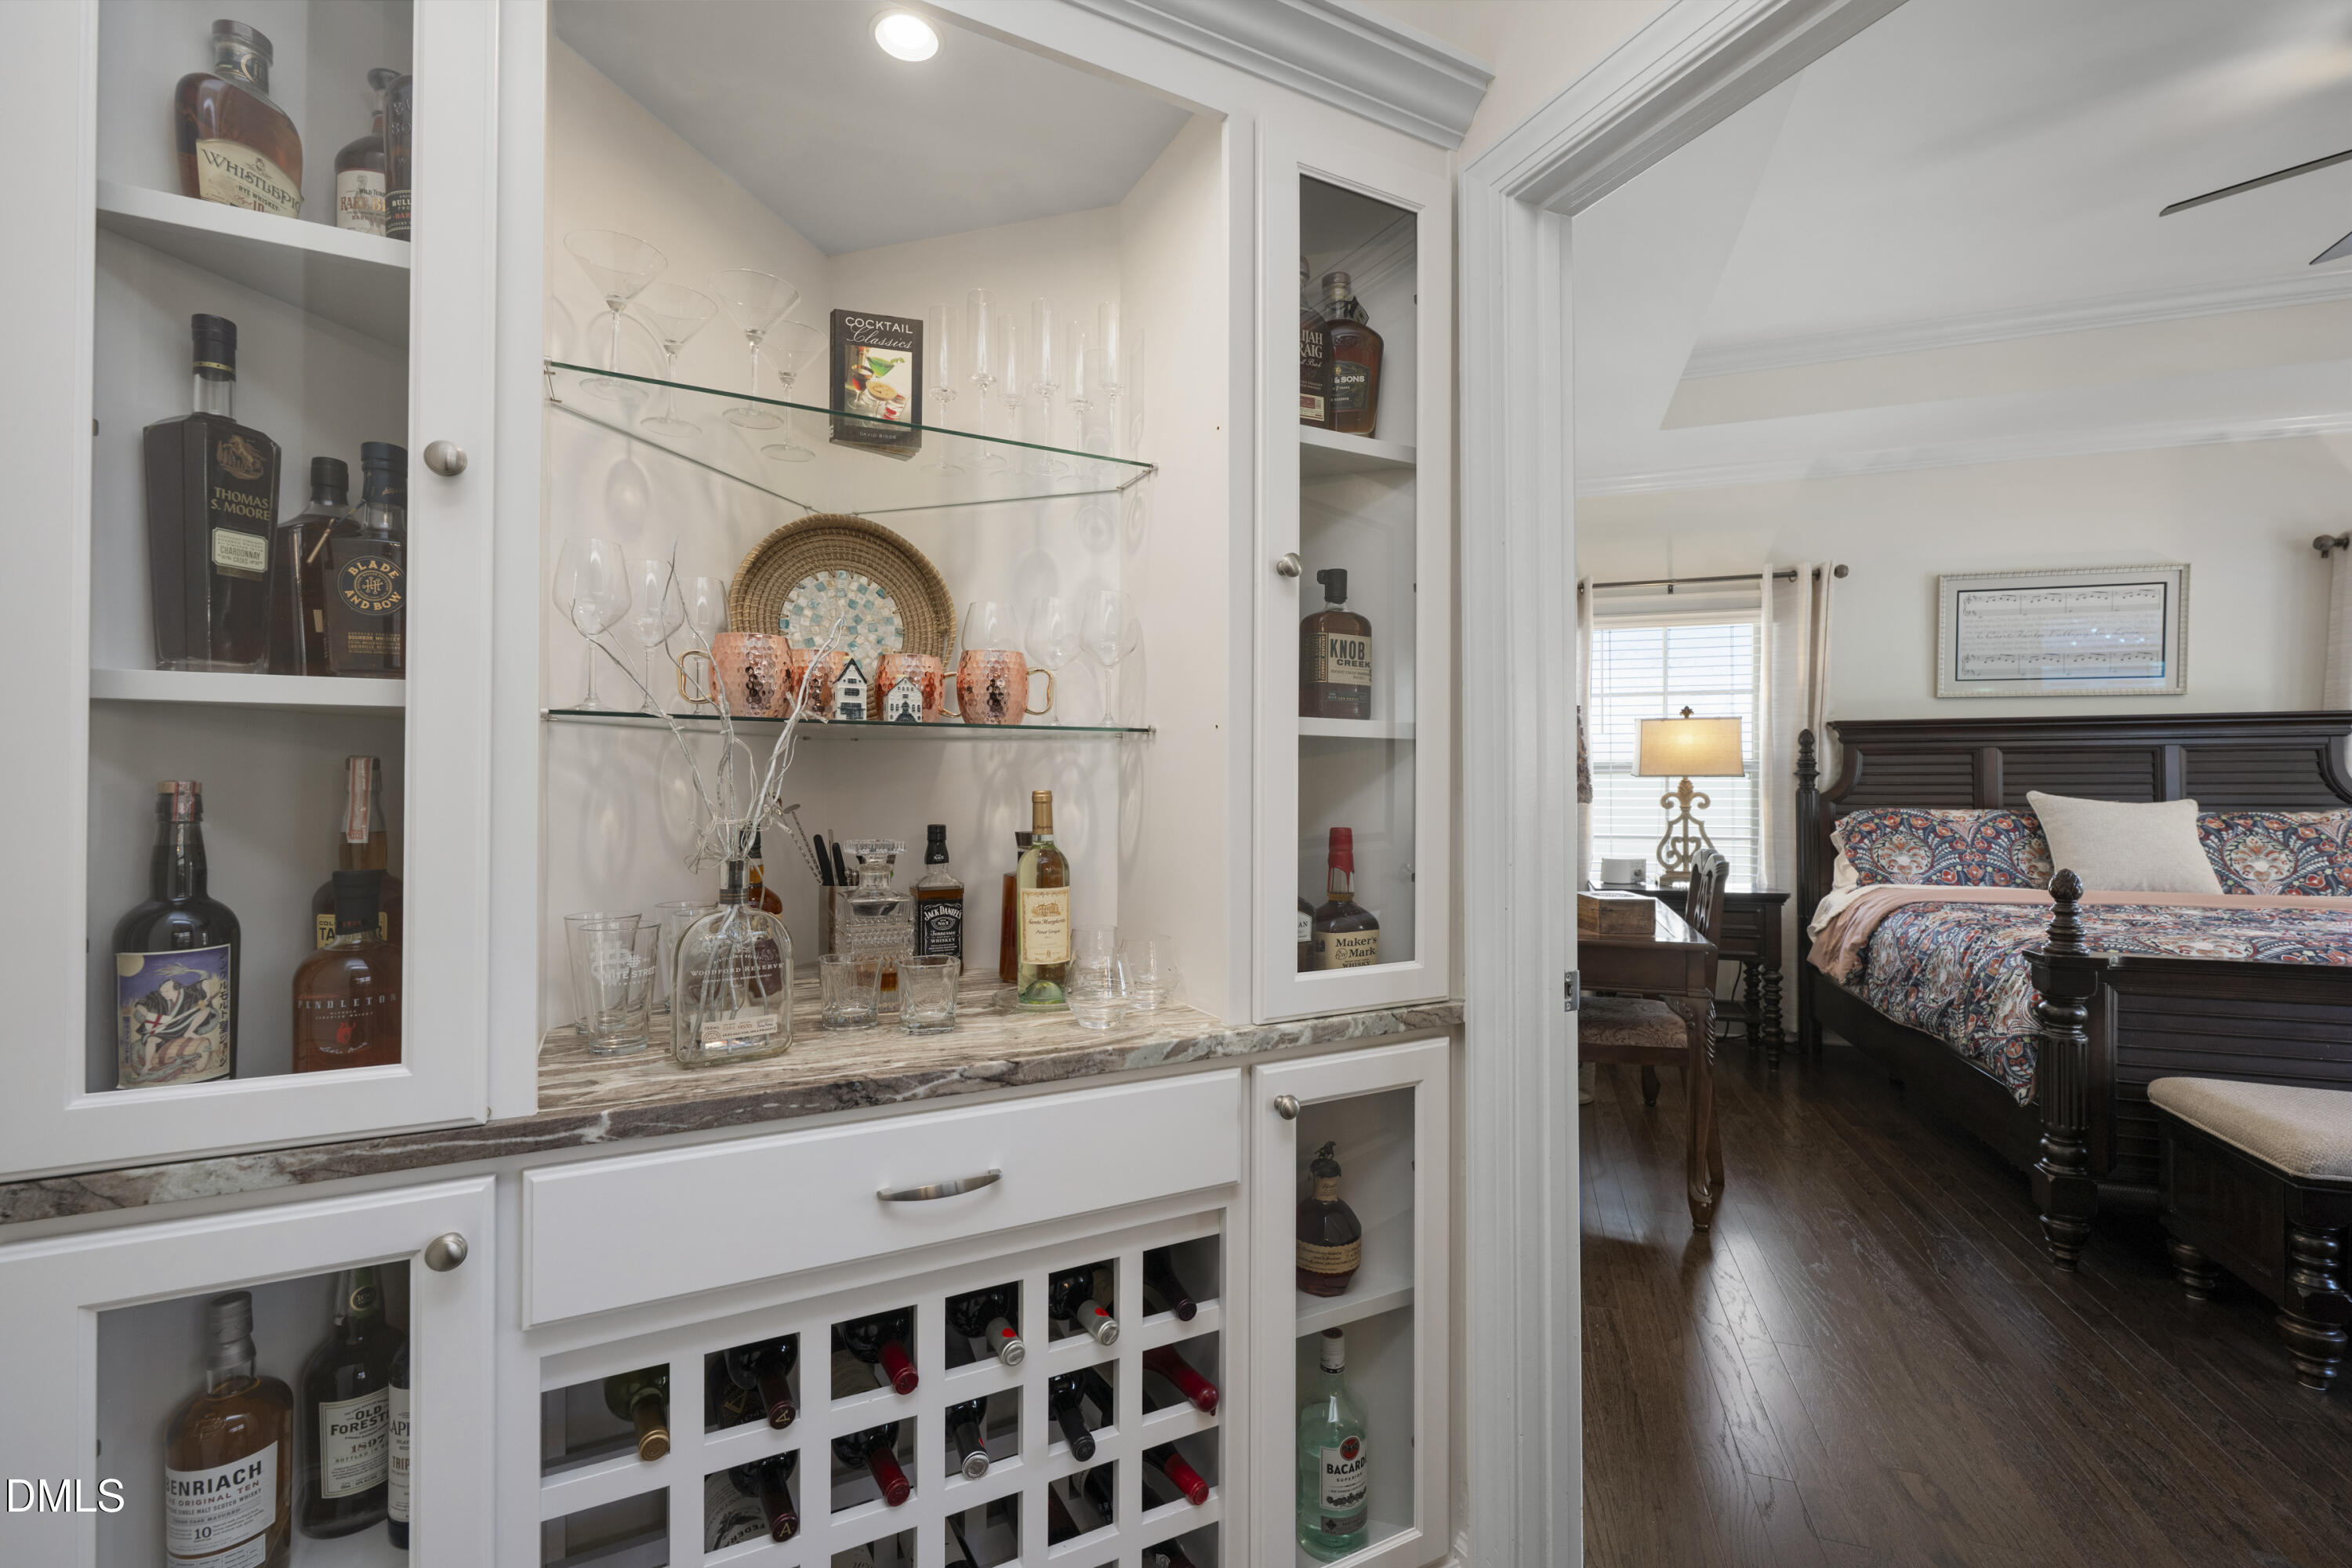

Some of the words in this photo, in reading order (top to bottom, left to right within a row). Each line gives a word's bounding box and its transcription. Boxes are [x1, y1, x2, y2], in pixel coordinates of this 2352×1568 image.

[392, 198, 411, 208] BULL
[845, 317, 913, 335] COCKTAIL
[846, 322, 913, 349] Classics
[214, 486, 270, 509] THOMAS
[211, 499, 220, 510] S.
[224, 501, 270, 521] MOORE
[220, 545, 260, 559] CHARDONNAY
[347, 560, 400, 579] BLADE
[344, 590, 370, 609] AND
[373, 591, 402, 611] BOW
[1330, 638, 1365, 660] KNOB
[1336, 659, 1371, 669] CREEK
[924, 907, 939, 921] JACK
[939, 905, 963, 920] DANIEL'S
[1335, 936, 1377, 948] Maker's
[1348, 946, 1376, 958] Mark
[690, 967, 742, 977] WOODFORD
[744, 962, 785, 972] RESERVE
[297, 993, 397, 1010] PENDLETON
[355, 1406, 383, 1421] OLD
[331, 1410, 389, 1436] FOREST
[335, 1451, 368, 1464] BOTTLED
[178, 1492, 232, 1507] ORIGINAL
[238, 1479, 260, 1494] TEN
[213, 1498, 237, 1512] SCOTCH
[239, 1488, 262, 1503] WHISKY
[194, 1526, 212, 1540] 10
[726, 1523, 766, 1548] FEDER
[779, 1522, 793, 1537] A
